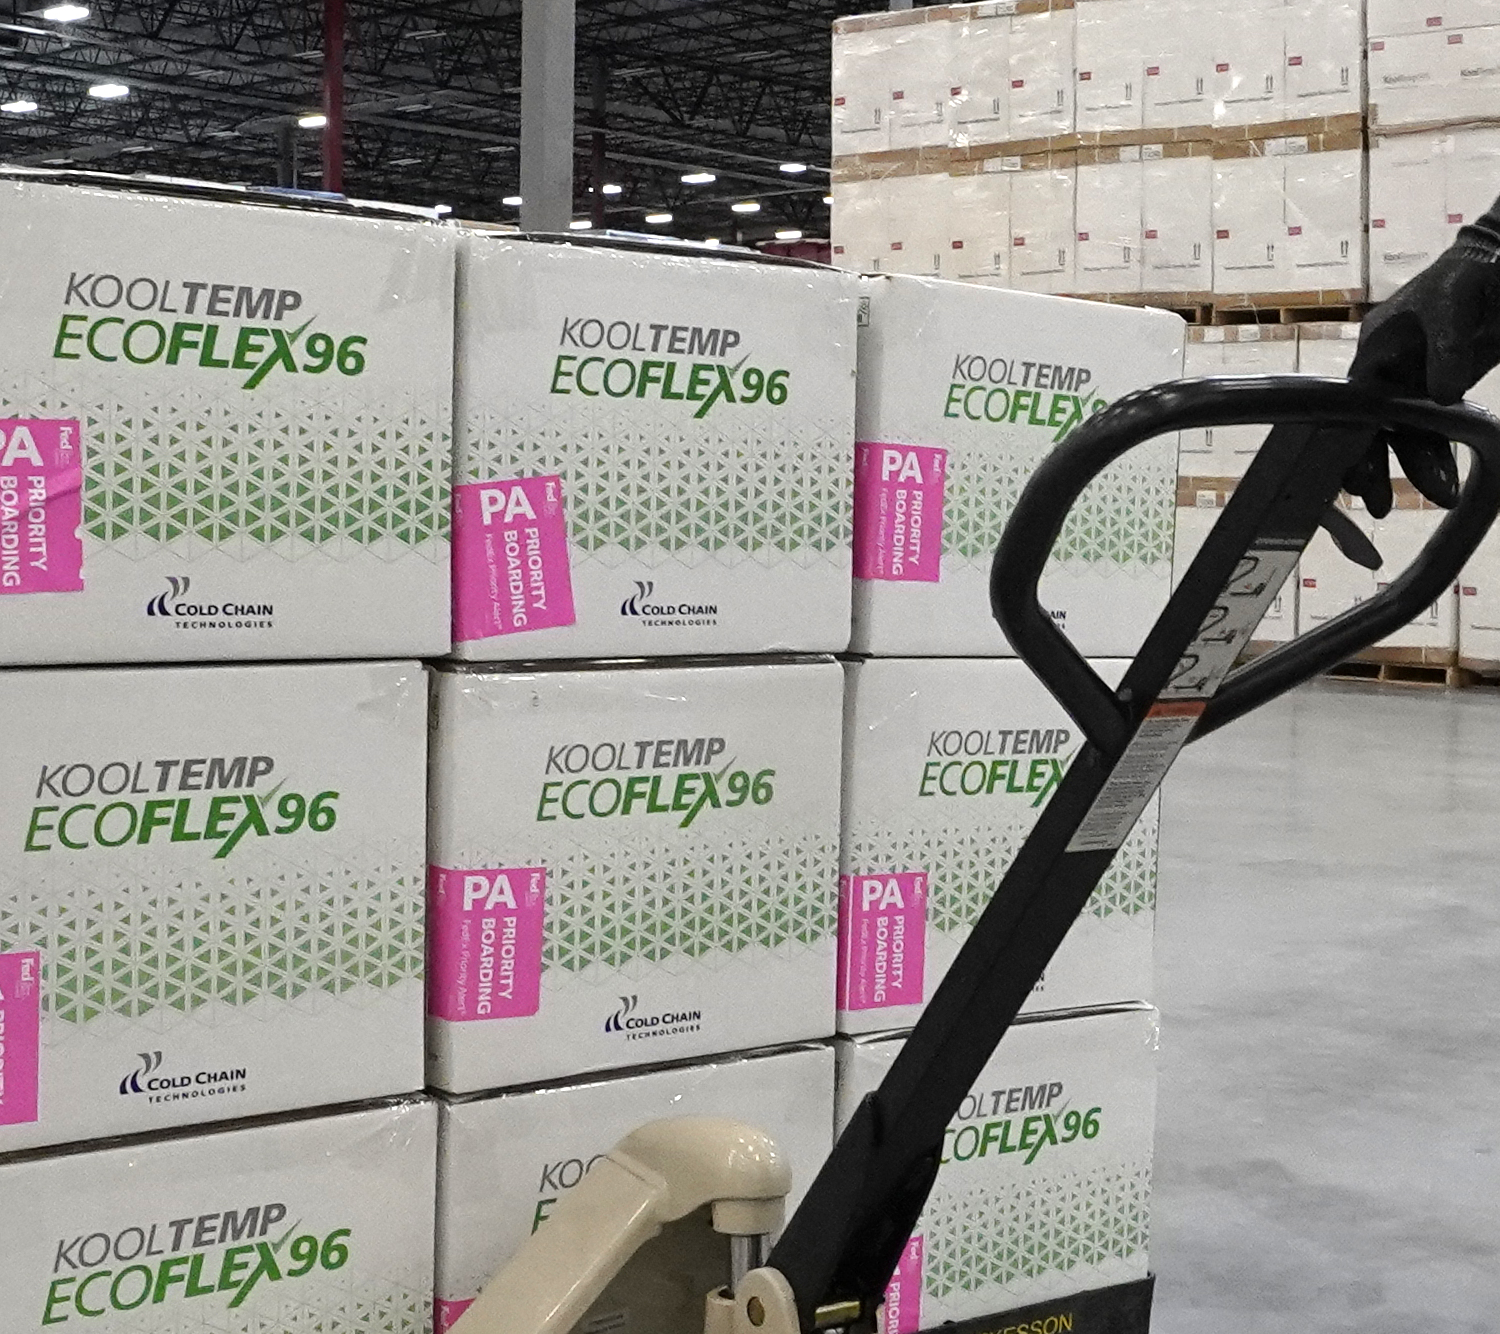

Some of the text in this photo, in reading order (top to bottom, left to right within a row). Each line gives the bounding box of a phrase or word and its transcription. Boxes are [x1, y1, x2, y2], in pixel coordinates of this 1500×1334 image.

[63, 272, 303, 322] KOOLTEMP
[52, 314, 369, 390] ECOFLEX96
[560, 317, 741, 357] KOOLTEMP
[550, 354, 791, 419] ECOFLEX96
[951, 354, 1092, 392] KOOLTEMP
[881, 449, 923, 485] PA
[27, 475, 49, 572] PRIORITY
[479, 485, 537, 526] PA
[0, 475, 22, 588] BOARDING
[892, 489, 907, 576] BOARDING
[910, 490, 924, 566] PRIORITY
[504, 529, 528, 628] BOARDING
[525, 527, 547, 611] PRIORITY
[175, 603, 274, 618] COLD CHAIN
[175, 619, 274, 629] TECHNOLOGIES
[642, 604, 718, 616] COLD CHAIN
[642, 619, 718, 627] TECHNOLOGIES
[545, 737, 726, 775] KOOLTEMP
[927, 729, 1071, 757] KOOLTEMP
[36, 756, 275, 799] KOOLTEMP
[536, 768, 776, 828] ECOFLEX96
[23, 790, 340, 859] ECOFLEX96
[463, 873, 519, 912] PA
[861, 878, 905, 913] PA
[477, 918, 497, 1016] BOARDING
[500, 916, 517, 1000] PRIORITY
[873, 916, 889, 1005] BOARDING
[891, 915, 905, 990] PRIORITY
[626, 1010, 702, 1030] COLD CHAIN
[626, 1023, 702, 1042] TECHNOLOGIES
[147, 1068, 247, 1091] COLD CHAIN
[148, 1083, 247, 1104] TECHNOLOGIES
[957, 1081, 1063, 1121] OLTEMP
[52, 1202, 288, 1274] KOOLTEMP
[41, 1227, 352, 1326] ECOFLEX96
